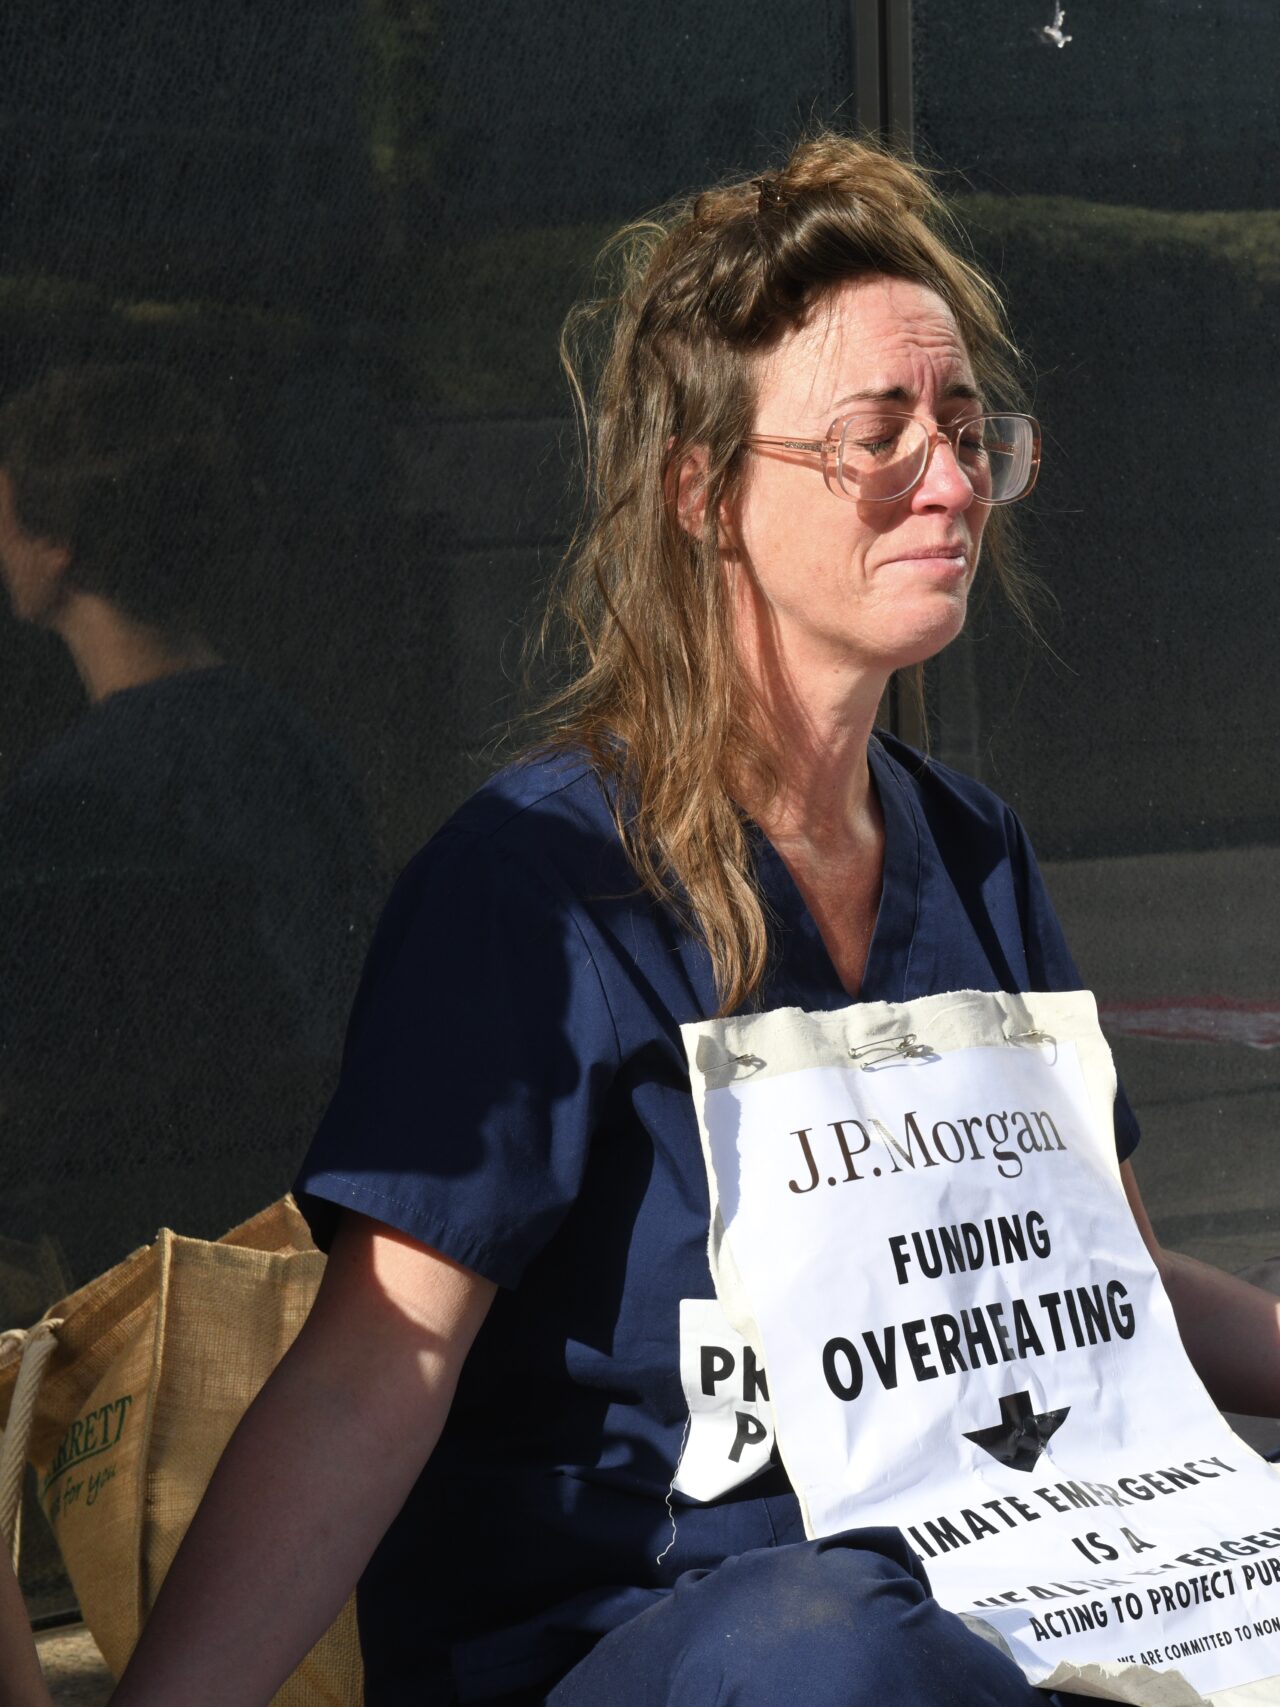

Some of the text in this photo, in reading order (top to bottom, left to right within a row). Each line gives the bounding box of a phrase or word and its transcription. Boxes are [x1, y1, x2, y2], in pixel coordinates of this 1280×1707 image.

[888, 1210, 1051, 1285] FUNDING
[822, 1280, 1136, 1401] OVERHEATING
[907, 1456, 1238, 1561] IMATE EMERGENCY
[1072, 1527, 1157, 1565] IS A
[1029, 1601, 1108, 1642] ACTING
[1111, 1593, 1144, 1624] TO
[1146, 1568, 1236, 1615] PROTECT
[1140, 1648, 1164, 1666] ARE
[1165, 1631, 1233, 1661] COMMITTED
[1234, 1625, 1253, 1642] TO
